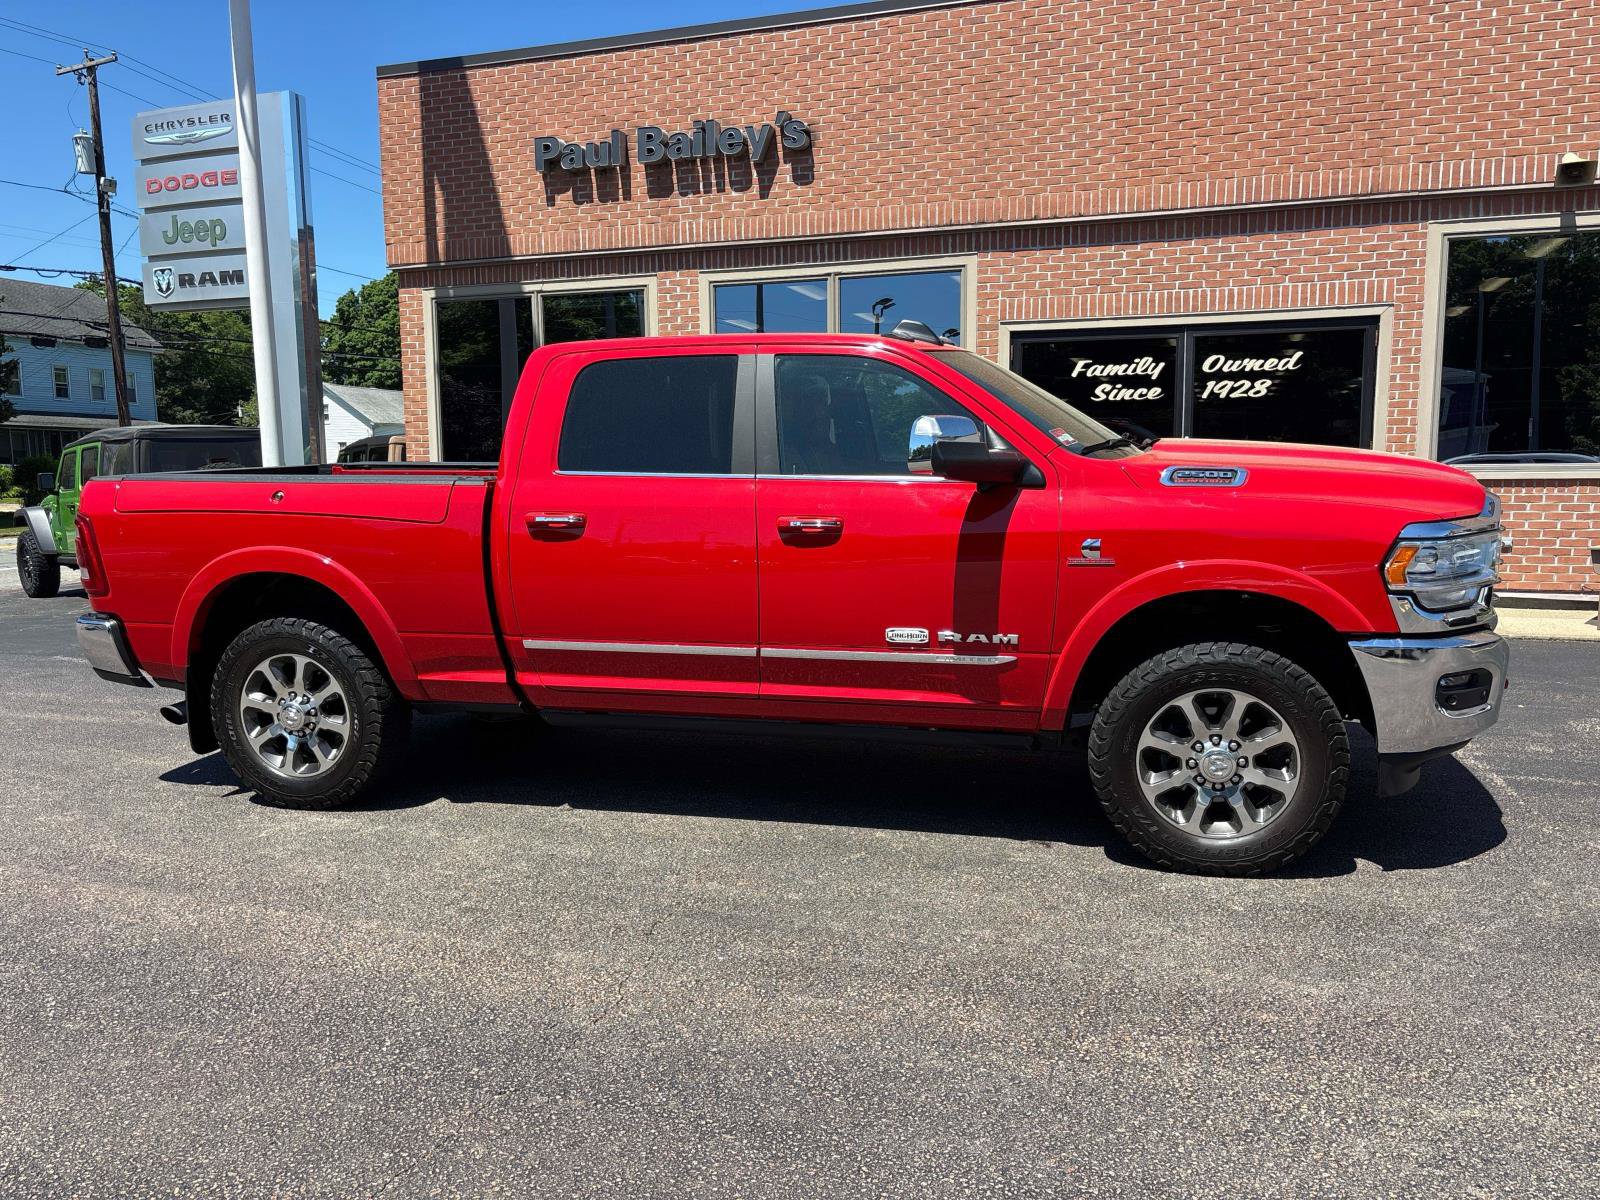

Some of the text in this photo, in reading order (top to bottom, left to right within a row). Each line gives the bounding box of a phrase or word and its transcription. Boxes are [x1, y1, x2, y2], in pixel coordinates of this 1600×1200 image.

[144, 113, 232, 133] CHRYSLER
[534, 111, 811, 172] Paul Bailey's
[146, 169, 238, 194] DODGE
[162, 215, 227, 247] Jeep
[178, 269, 245, 288] RAM
[1071, 351, 1304, 380] Family Owned
[1090, 379, 1273, 402] Since 1928
[937, 631, 1019, 645] RAM
